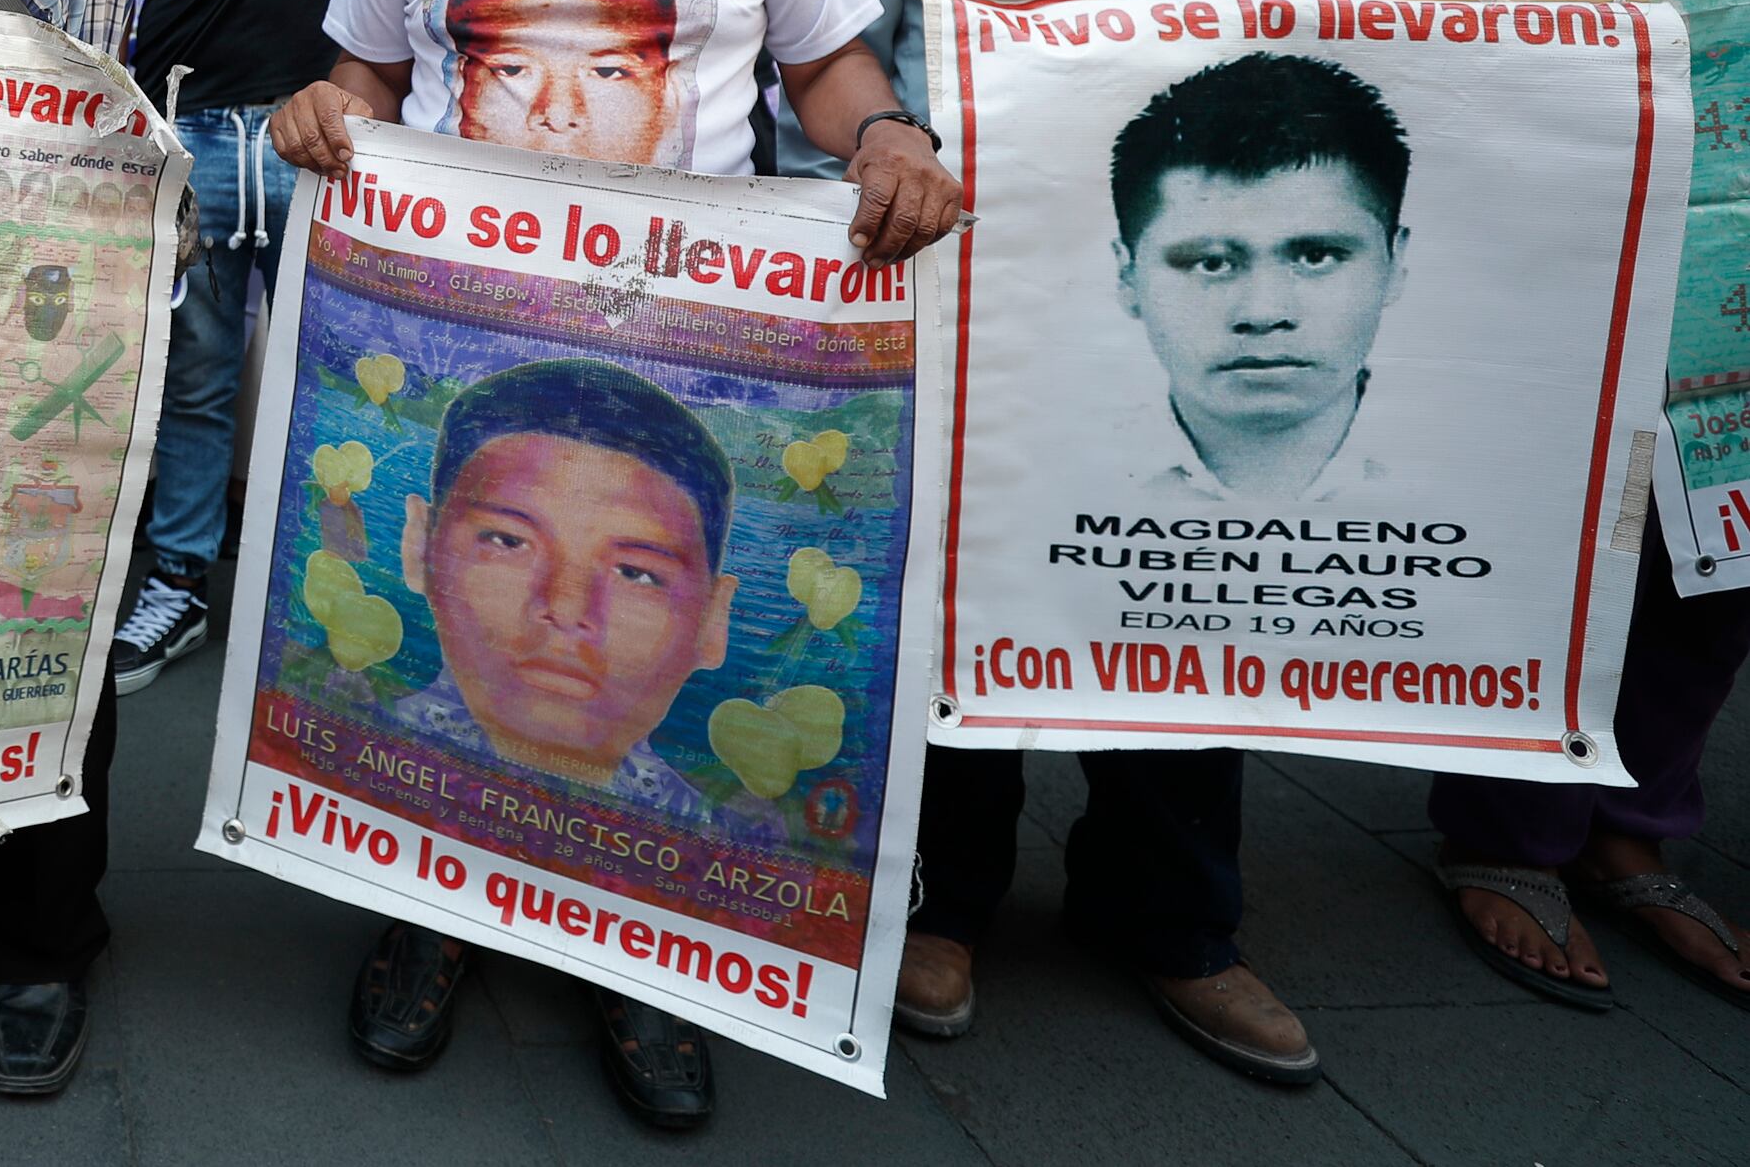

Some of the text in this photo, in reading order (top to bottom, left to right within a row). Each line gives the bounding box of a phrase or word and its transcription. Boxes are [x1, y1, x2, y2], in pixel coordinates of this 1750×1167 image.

[980, 8, 1136, 53] ¡Vivo
[1159, 1, 1220, 42] se
[19, 147, 63, 165] saber
[70, 154, 114, 172] dónde
[320, 173, 447, 239] ¡Vivo
[467, 205, 542, 255] se
[562, 204, 621, 267] lo
[316, 235, 337, 257] Yo,
[346, 247, 371, 272] Jan
[377, 260, 436, 289] Nimmo,
[450, 275, 538, 306] Glasgow,
[656, 309, 728, 338] quiero
[741, 322, 804, 349] saber
[1693, 445, 1733, 463] Hijo
[1075, 513, 1468, 546] MAGDALENO
[1049, 544, 1492, 578] RUBÉN LAURO
[1118, 580, 1418, 609] VILLEGAS
[1120, 611, 1424, 639] EDAD 19 AÑOS
[2, 683, 66, 702] GUERRERO
[974, 637, 1542, 711] ¡Con VIDA lo queremos!
[266, 706, 851, 922] LUÍS ÁNGEL FRANCISCO ARZOLA
[300, 749, 336, 771] Hijo
[344, 765, 362, 781] de
[369, 777, 434, 810] Lorenzo
[440, 805, 451, 821] y
[457, 810, 525, 845] Benigna
[554, 842, 575, 858] 20
[583, 850, 625, 876] años
[655, 875, 688, 895] San
[697, 887, 793, 929] Cristóbal
[266, 783, 814, 1020] ¡Vivo lo queremos!
